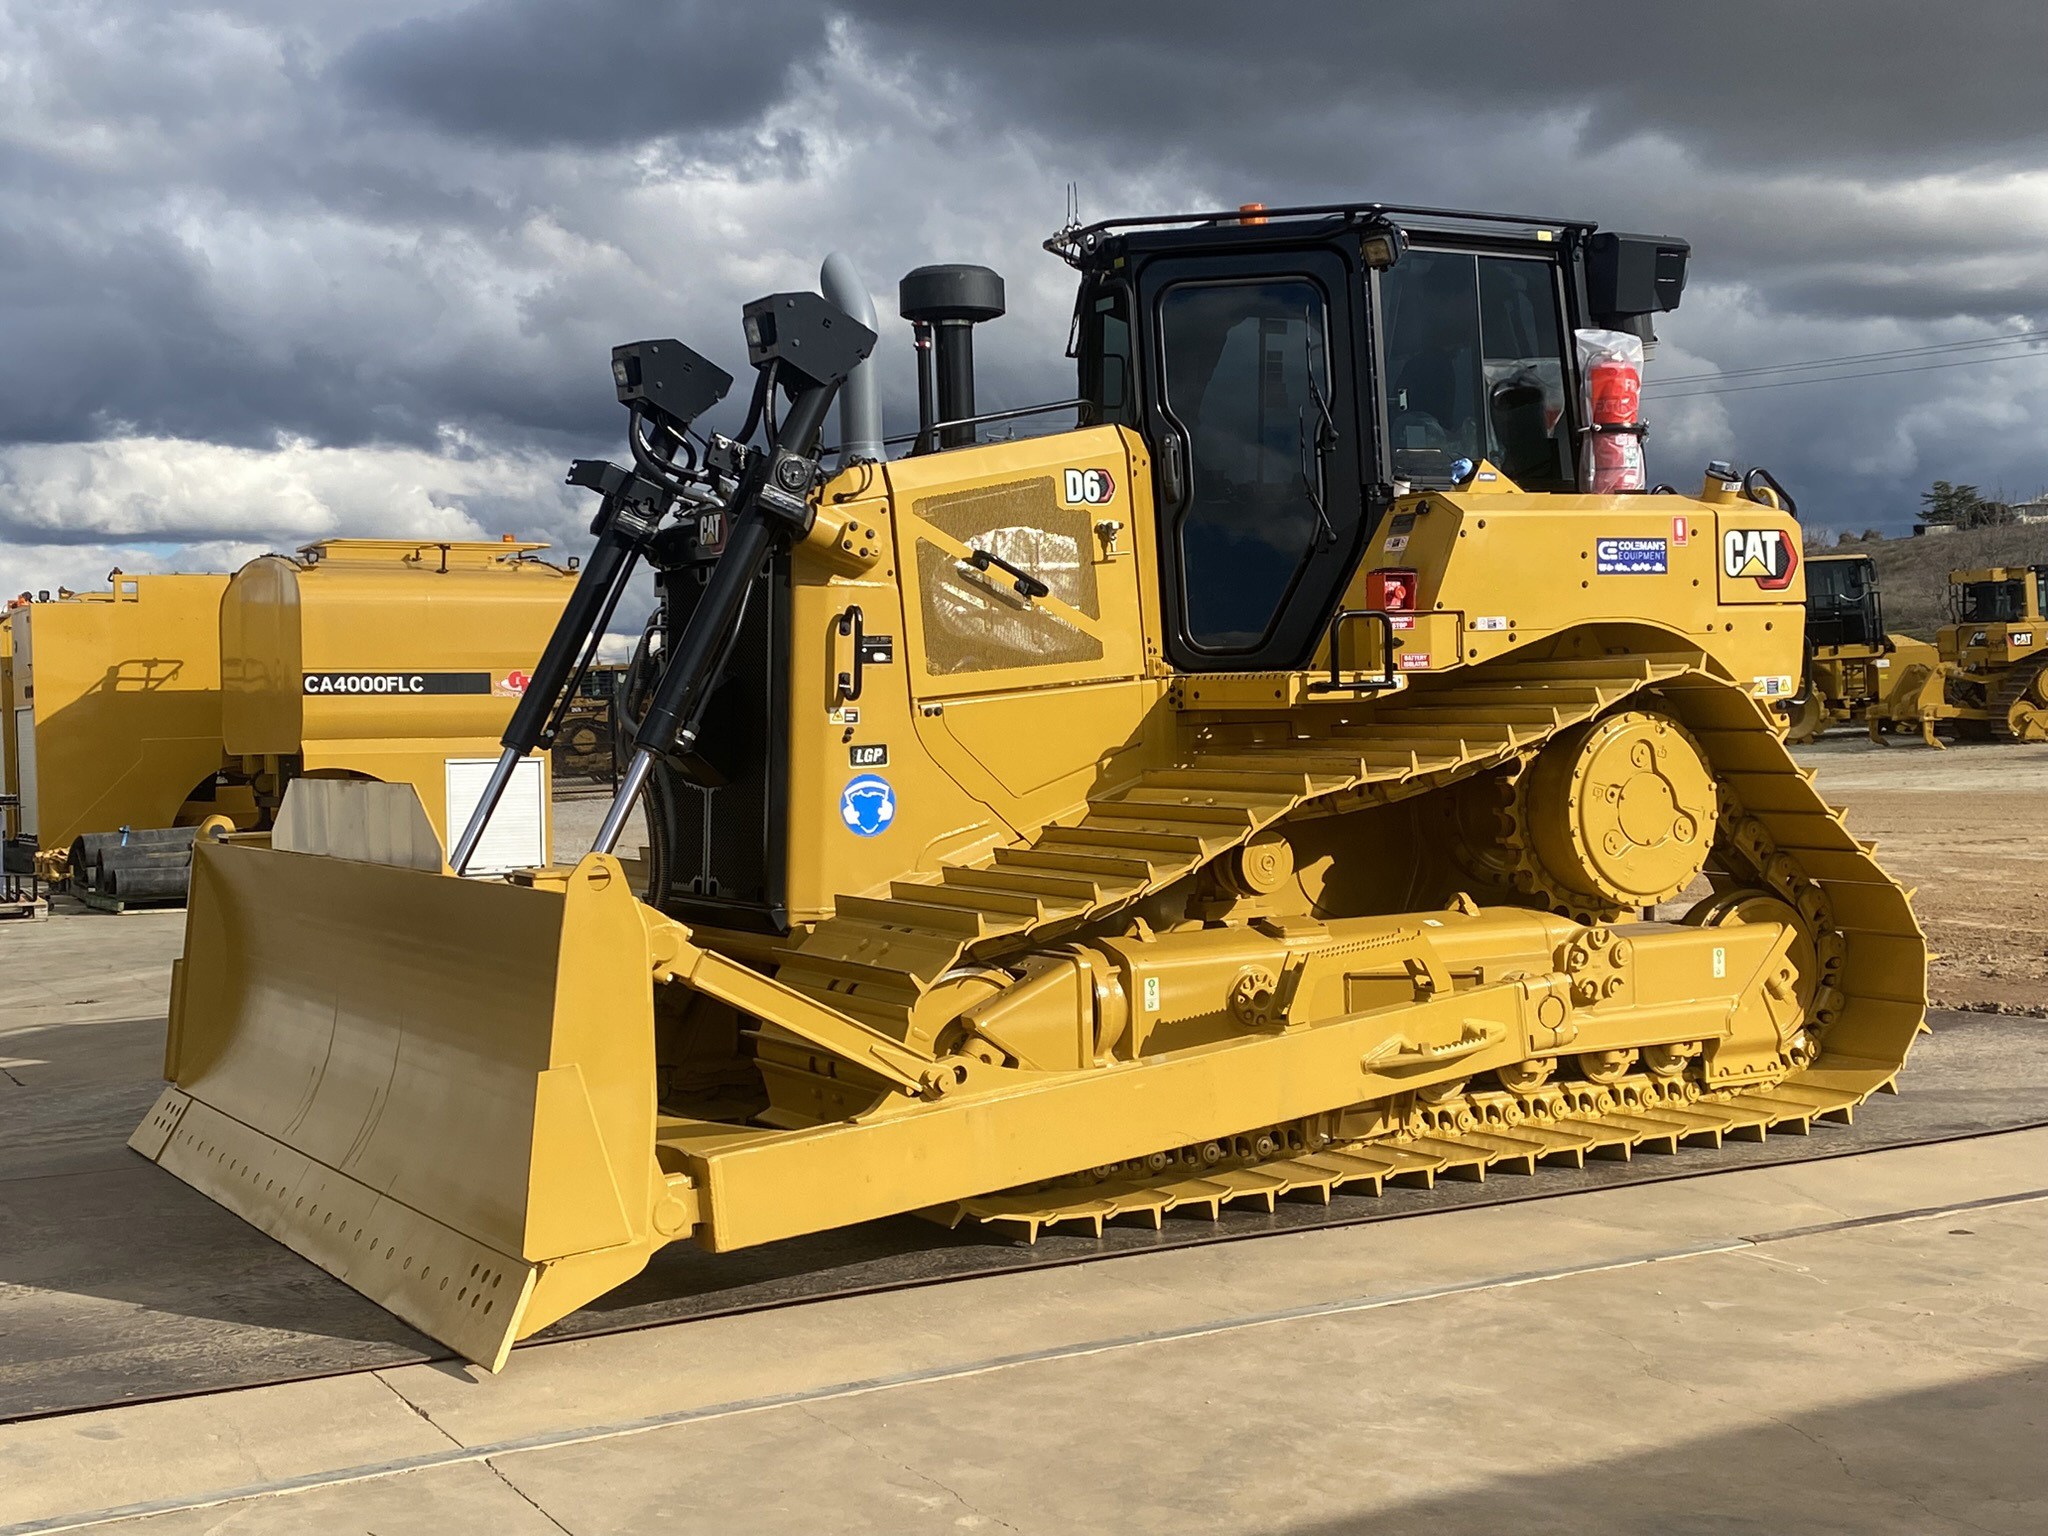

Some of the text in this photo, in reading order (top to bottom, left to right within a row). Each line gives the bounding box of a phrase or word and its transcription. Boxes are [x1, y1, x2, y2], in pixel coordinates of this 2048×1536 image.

[1065, 469, 1101, 503] D6
[700, 513, 721, 546] CAT
[1618, 541, 1666, 551] COLEMAN'S
[1724, 530, 1780, 577] CAT
[1618, 551, 1666, 561] EQUIPMENT
[2014, 633, 2032, 645] CAT
[304, 676, 425, 693] CA4000FLC
[855, 747, 883, 763] LGP
